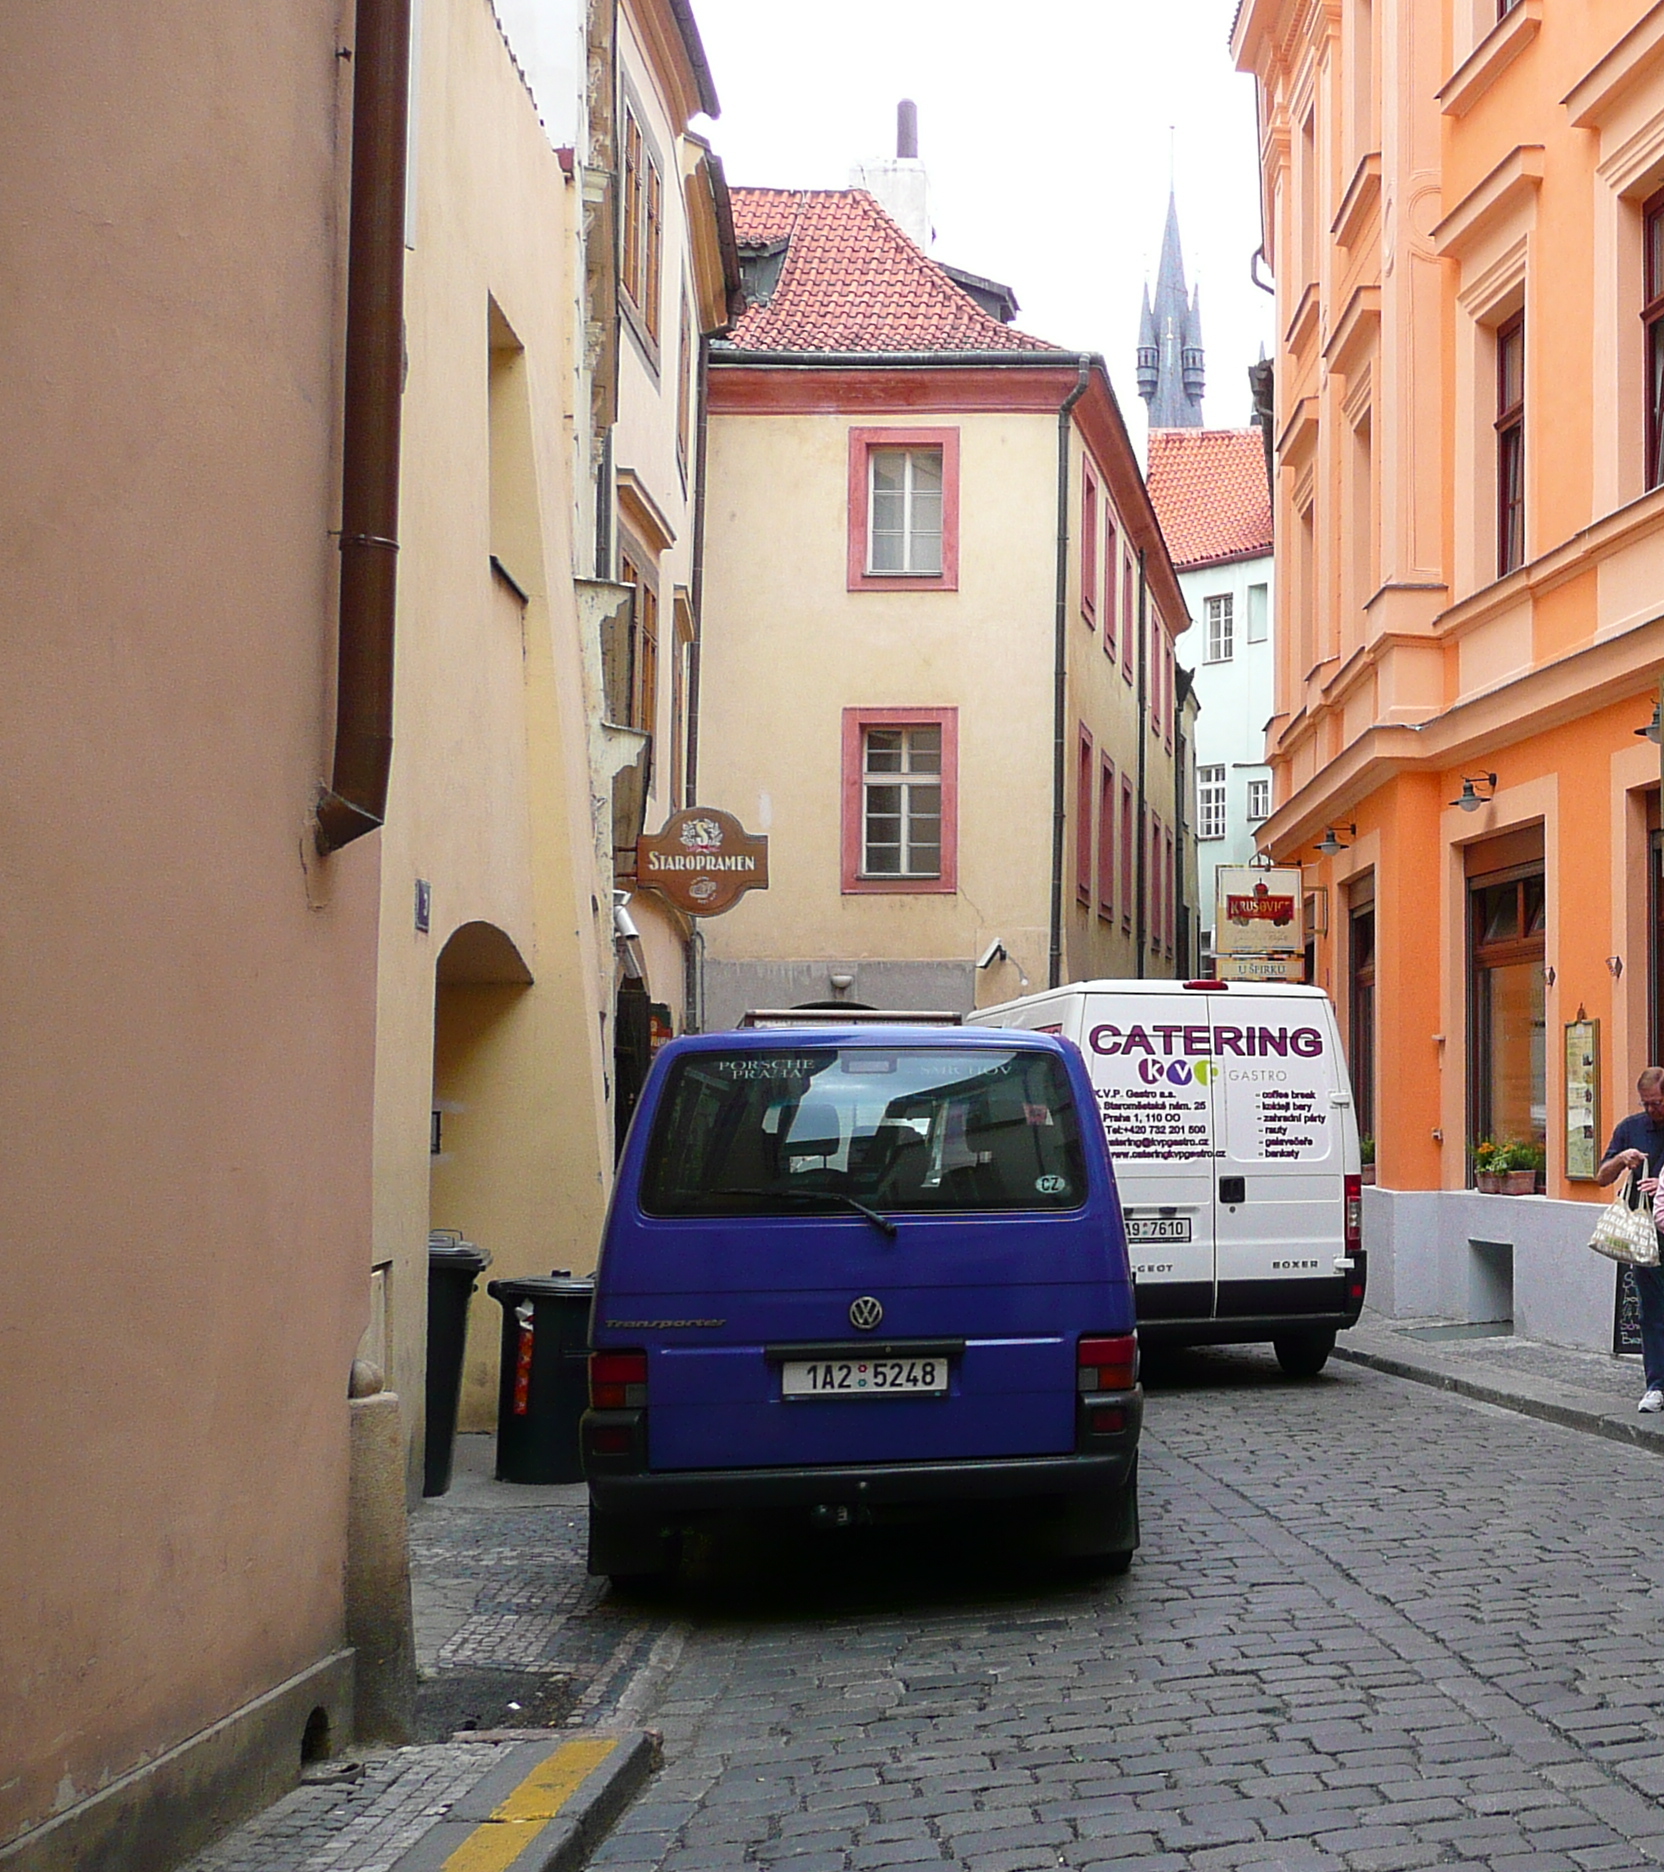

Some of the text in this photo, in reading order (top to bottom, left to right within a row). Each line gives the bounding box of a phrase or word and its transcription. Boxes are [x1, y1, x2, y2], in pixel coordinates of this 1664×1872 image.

[648, 851, 756, 871] STAROPRAMEN
[1238, 965, 1247, 975] U
[1088, 1023, 1324, 1058] CATERING
[718, 1058, 815, 1071] PORSCHE
[1228, 1069, 1288, 1082] GASTRO
[1125, 1088, 1157, 1099] Gastro
[1262, 1089, 1316, 1100] coffee break
[1168, 1100, 1192, 1111] nám.
[1292, 1101, 1312, 1113] bary
[1103, 1112, 1131, 1123] Praha
[1133, 1112, 1143, 1124] 1,
[1145, 1112, 1163, 1123] 110
[1263, 1113, 1326, 1124] zahradní párty
[1148, 1124, 1167, 1135] 732
[1168, 1124, 1185, 1135] 201
[1265, 1125, 1288, 1136] rauty
[1040, 1177, 1060, 1192] CZ
[1125, 1221, 1184, 1236] A9 7610
[1132, 1260, 1319, 1273] GEOT BOXER
[605, 1318, 728, 1330] Transporter
[805, 1360, 936, 1391] 1A2 5248
